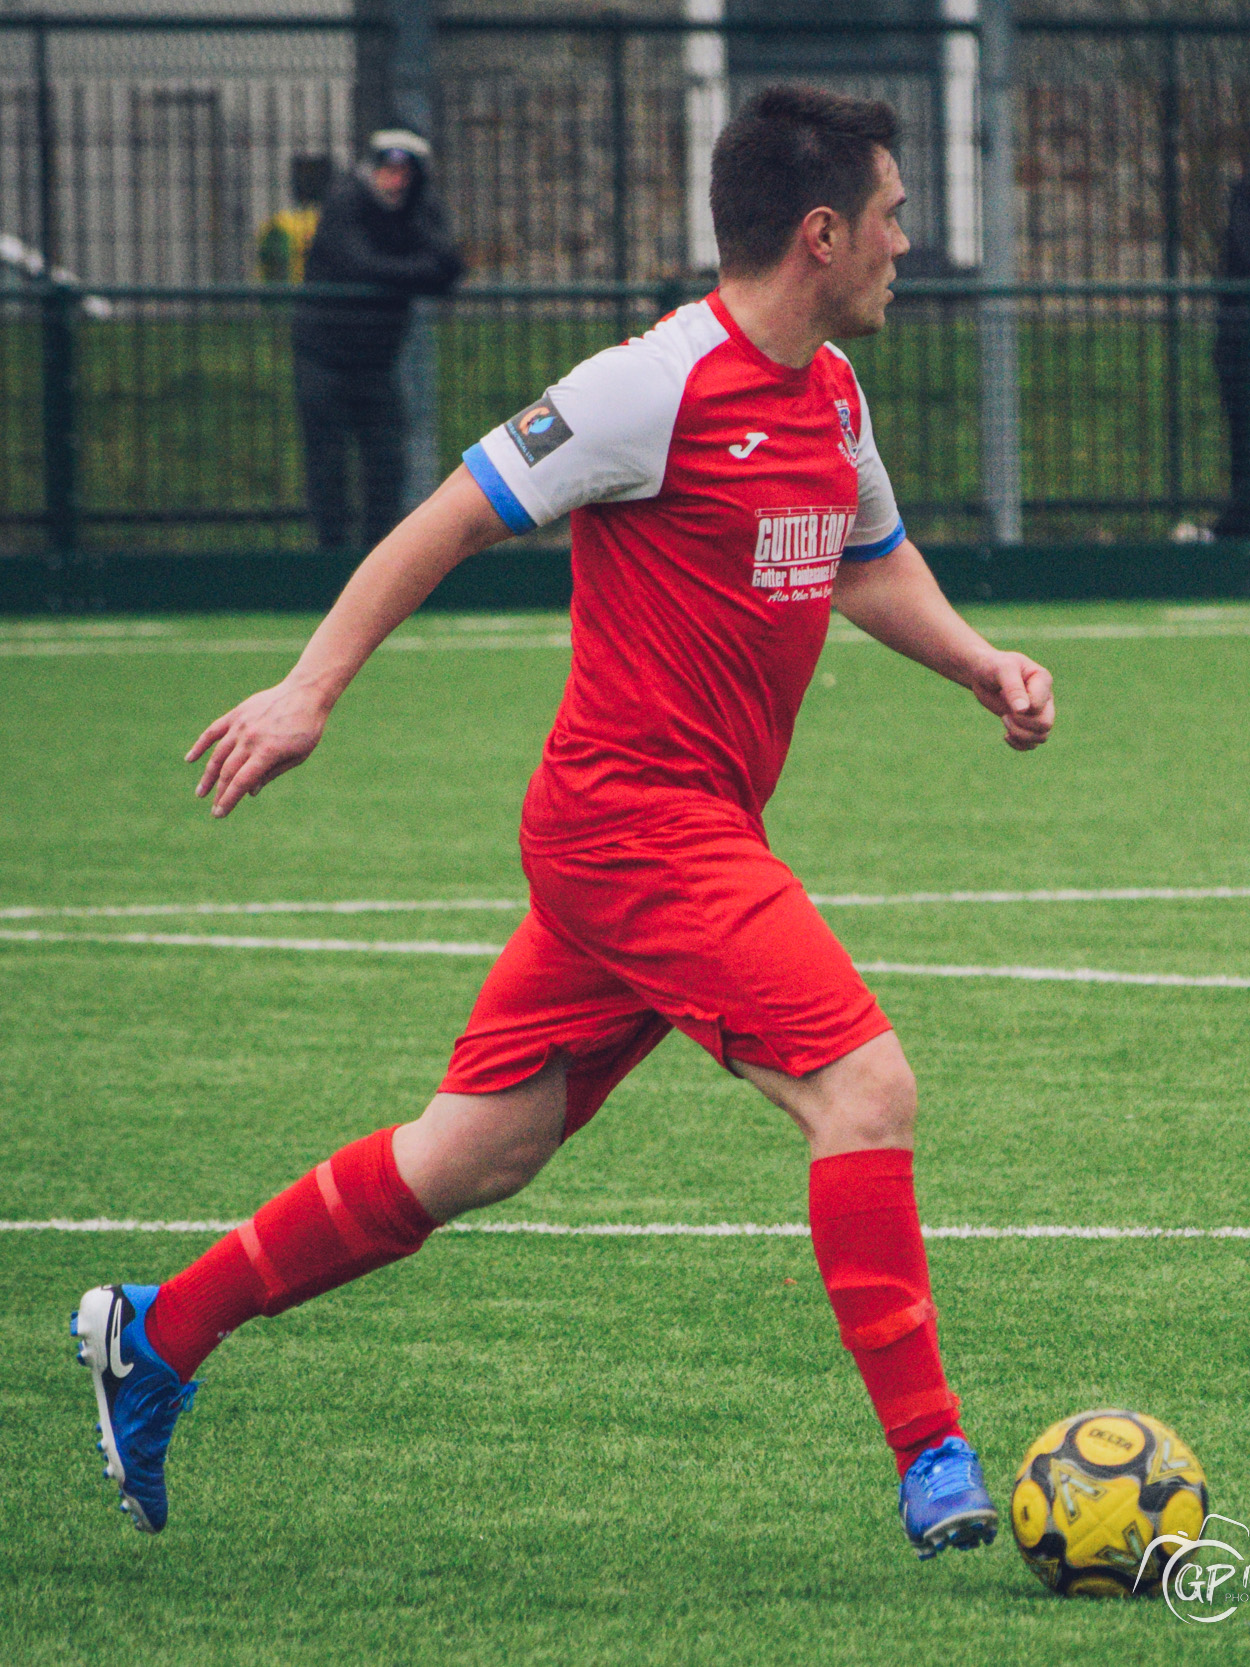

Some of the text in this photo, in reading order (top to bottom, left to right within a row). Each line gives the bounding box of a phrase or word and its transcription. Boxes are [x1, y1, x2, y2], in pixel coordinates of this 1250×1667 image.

[754, 514, 819, 562] GUTTER
[819, 513, 847, 556] FOR
[751, 567, 787, 588] Gutter
